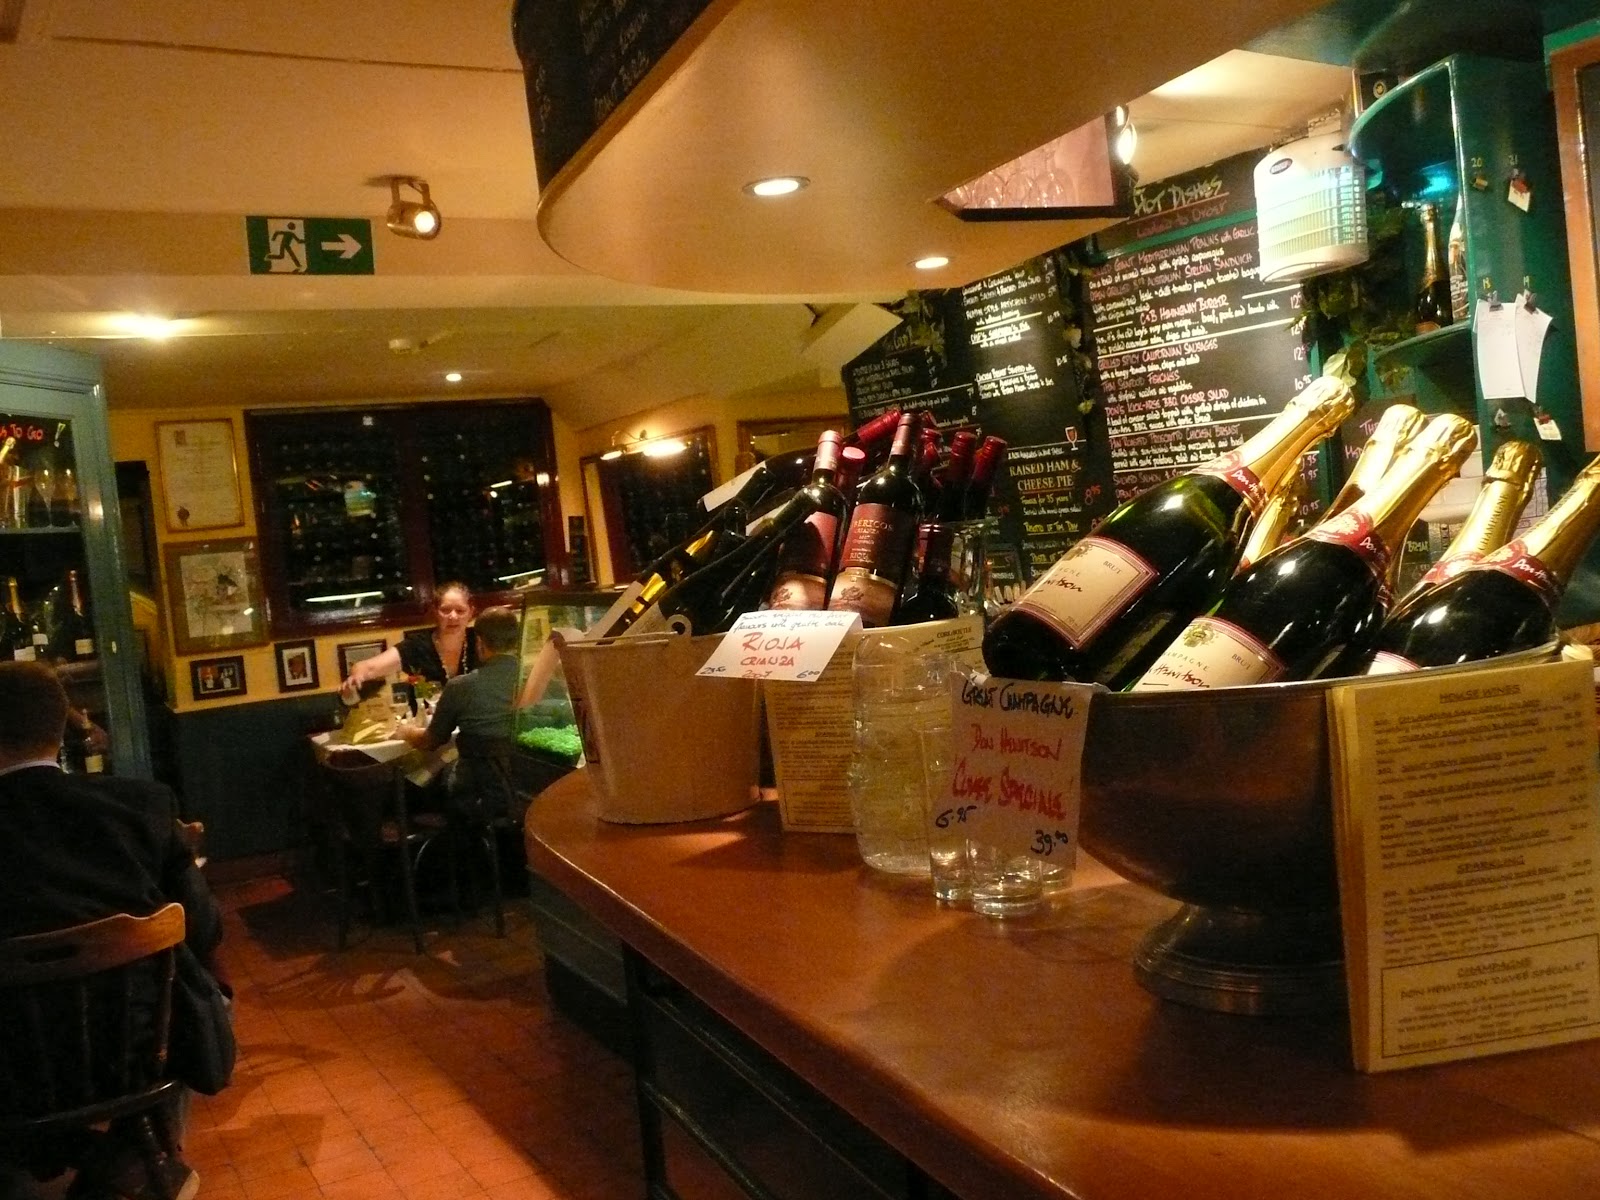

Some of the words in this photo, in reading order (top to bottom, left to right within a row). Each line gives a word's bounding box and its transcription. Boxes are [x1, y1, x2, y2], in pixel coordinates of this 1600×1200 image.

[1471, 158, 1482, 167] 20
[1133, 187, 1166, 216] HOT
[1168, 175, 1222, 209] DISHES
[1214, 253, 1253, 270] SANDWICH
[1207, 388, 1229, 401] SALAD
[10, 424, 22, 438] To
[27, 425, 43, 440] Go
[1009, 463, 1044, 477] RAISED
[1046, 460, 1070, 473] HAM
[1071, 460, 1081, 473] &
[1017, 477, 1055, 491] CHEESE
[1056, 475, 1074, 487] PIE
[1478, 494, 1508, 551] CHAMPAGNE
[1103, 560, 1122, 574] BRUT
[742, 632, 804, 651] RIOJA
[740, 656, 794, 667] CRIANZA
[1232, 653, 1252, 670] BRUT
[971, 723, 994, 751] DON
